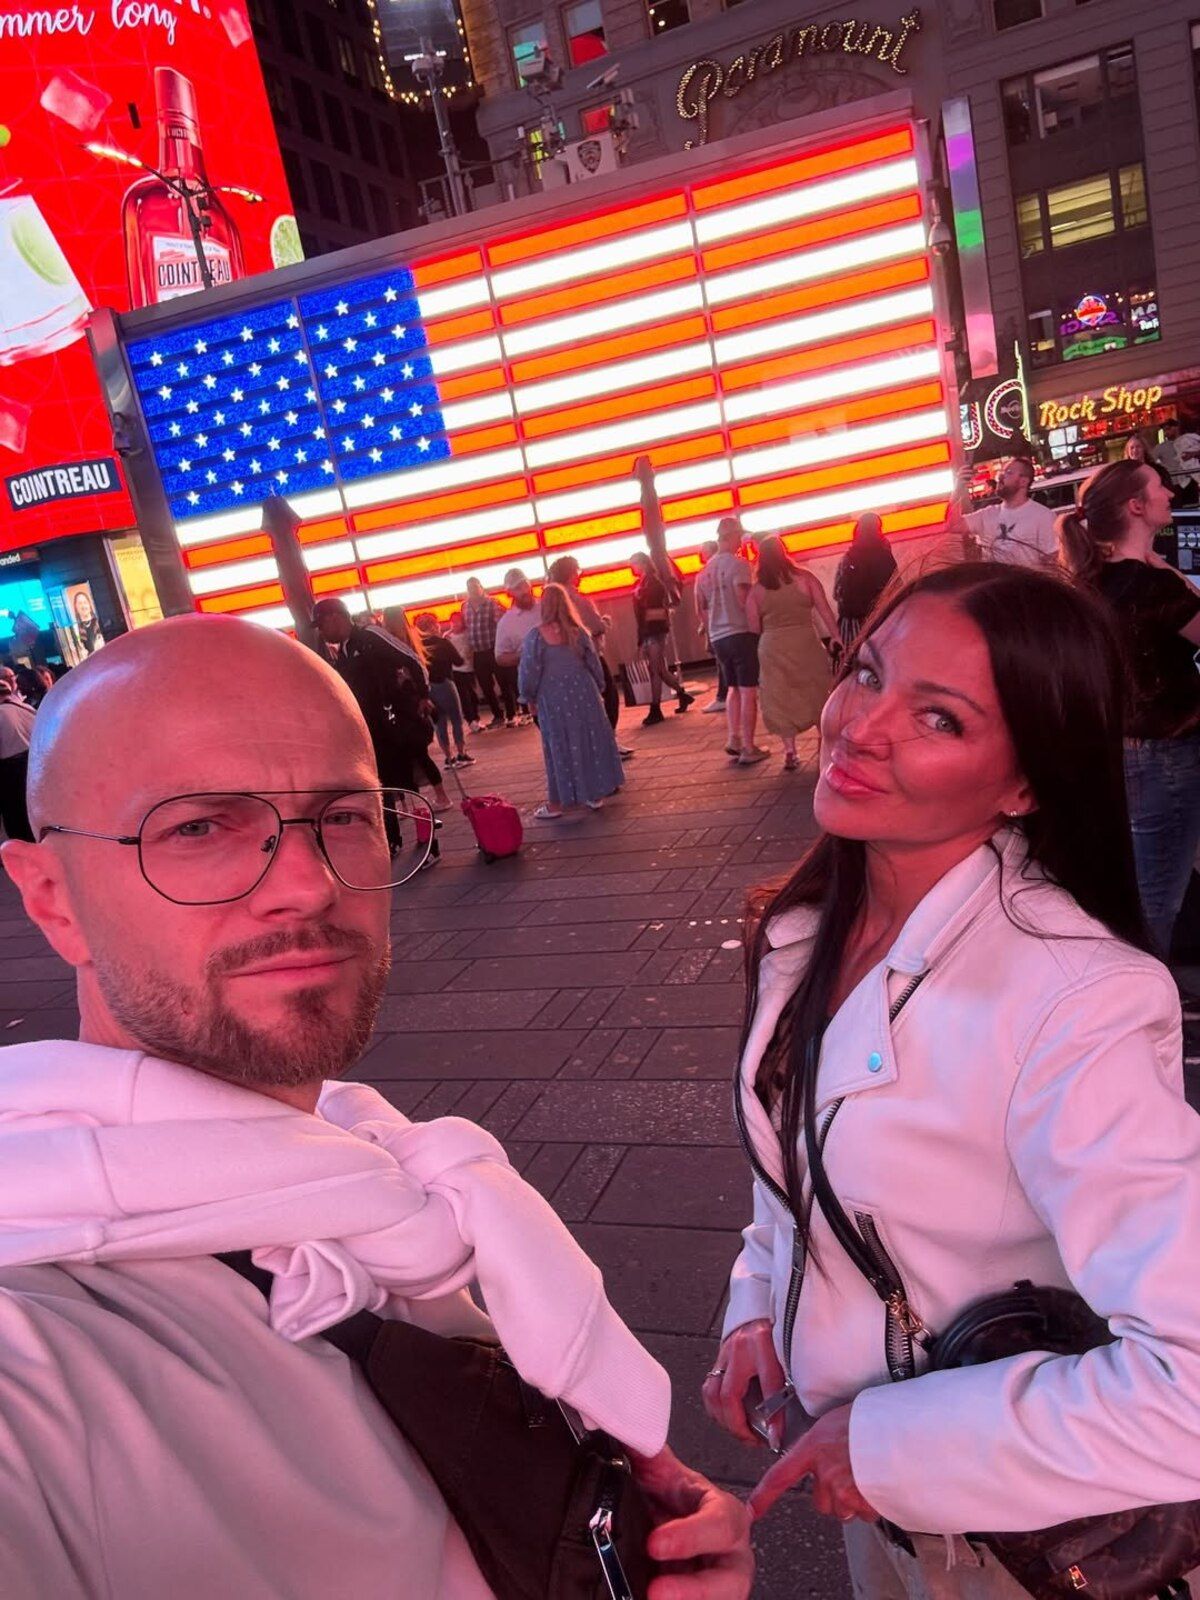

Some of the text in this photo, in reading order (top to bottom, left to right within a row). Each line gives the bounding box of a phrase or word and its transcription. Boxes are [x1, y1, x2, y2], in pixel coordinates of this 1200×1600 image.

[111, 0, 178, 46] long
[676, 8, 921, 152] Paramount
[158, 258, 231, 287] COINTEAU
[1039, 394, 1097, 429] Rock
[1101, 385, 1163, 414] Shop
[10, 463, 111, 507] COINTREAU
